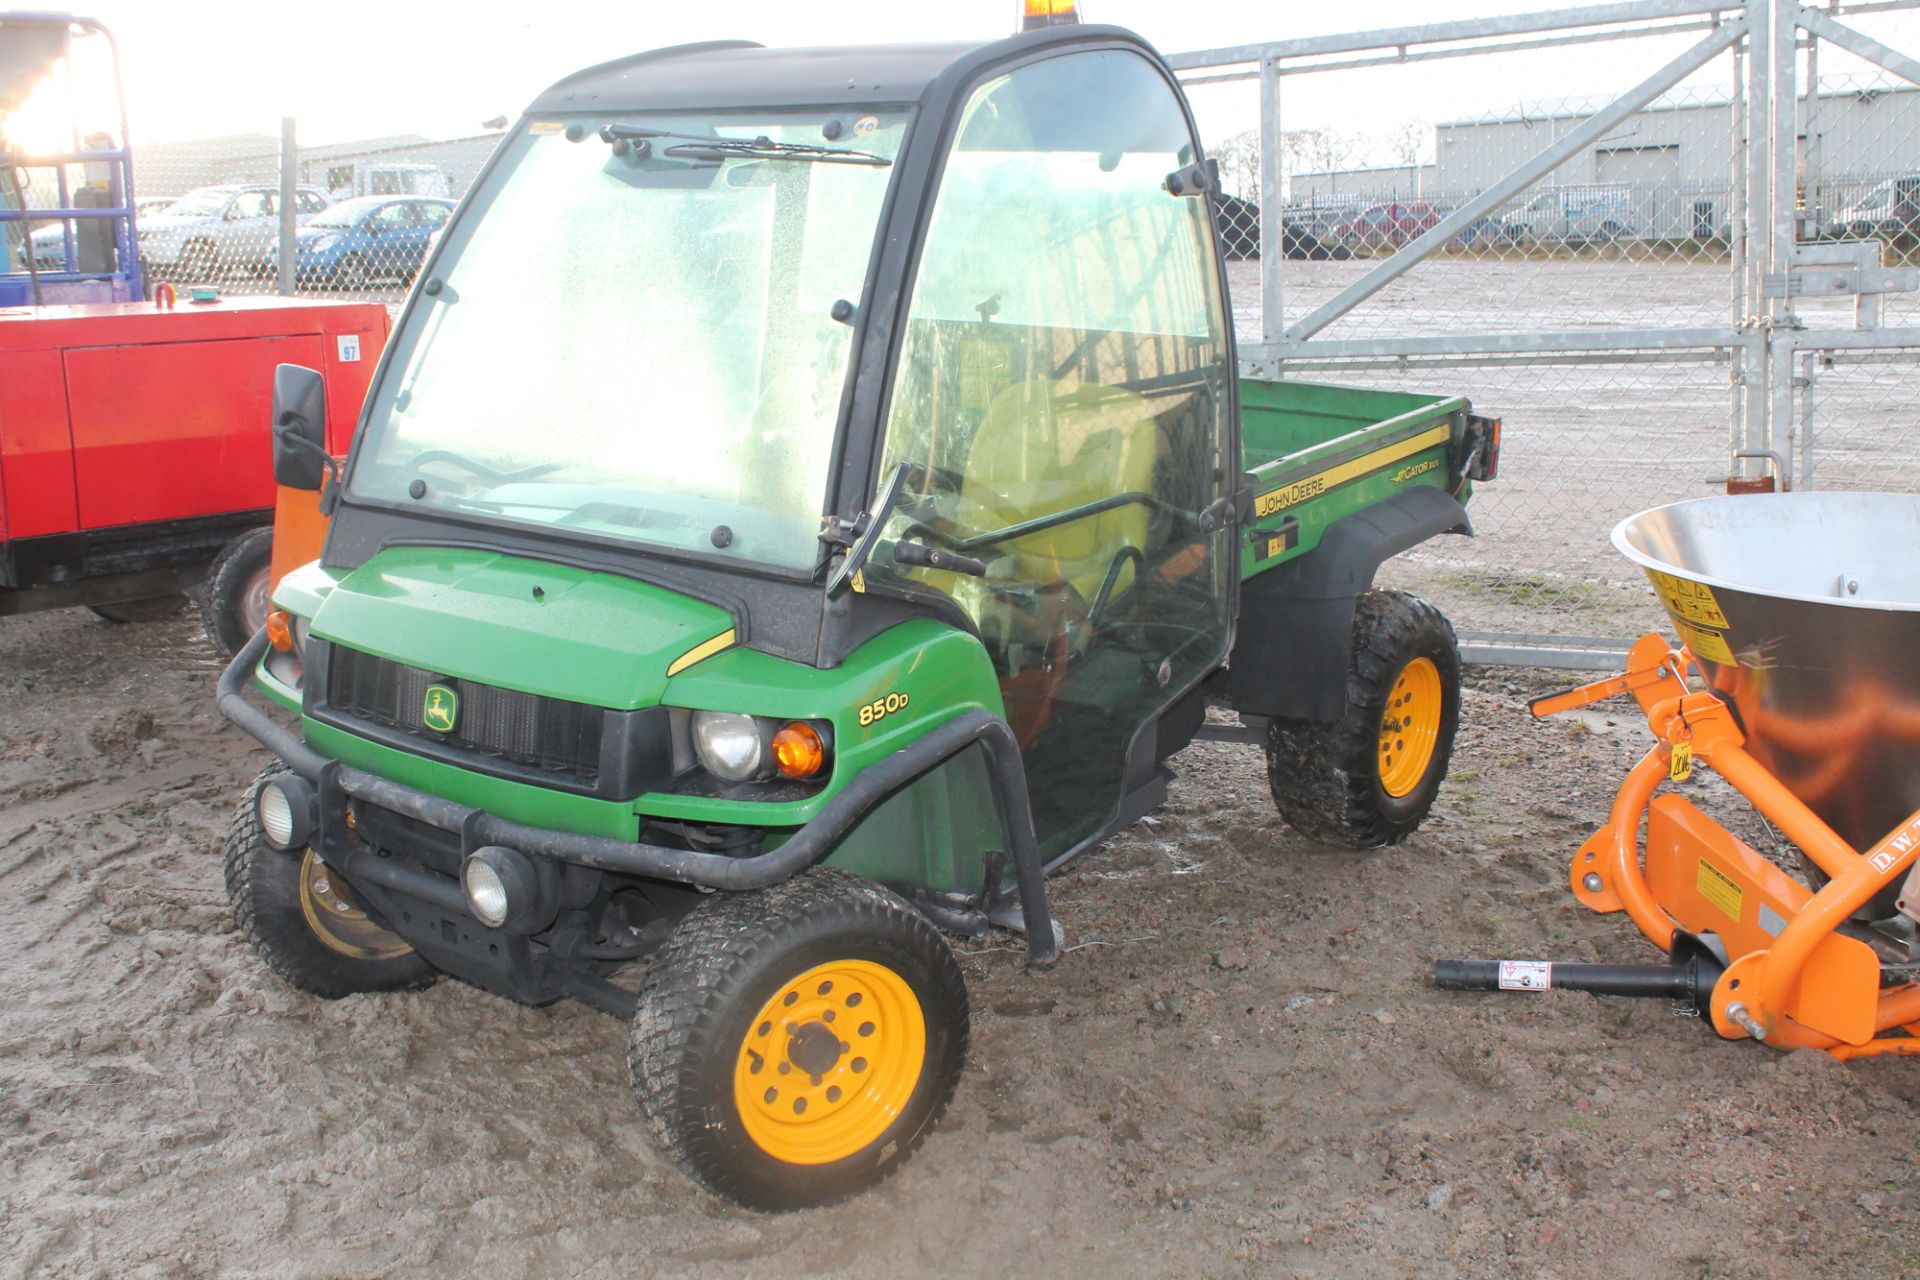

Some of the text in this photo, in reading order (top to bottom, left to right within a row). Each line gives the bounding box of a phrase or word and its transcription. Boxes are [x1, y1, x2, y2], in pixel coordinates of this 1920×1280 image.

[343, 346, 356, 361] 97
[1405, 461, 1429, 480] GATOR
[1262, 478, 1324, 514] JOHN DEERE
[859, 692, 909, 726] 850D
